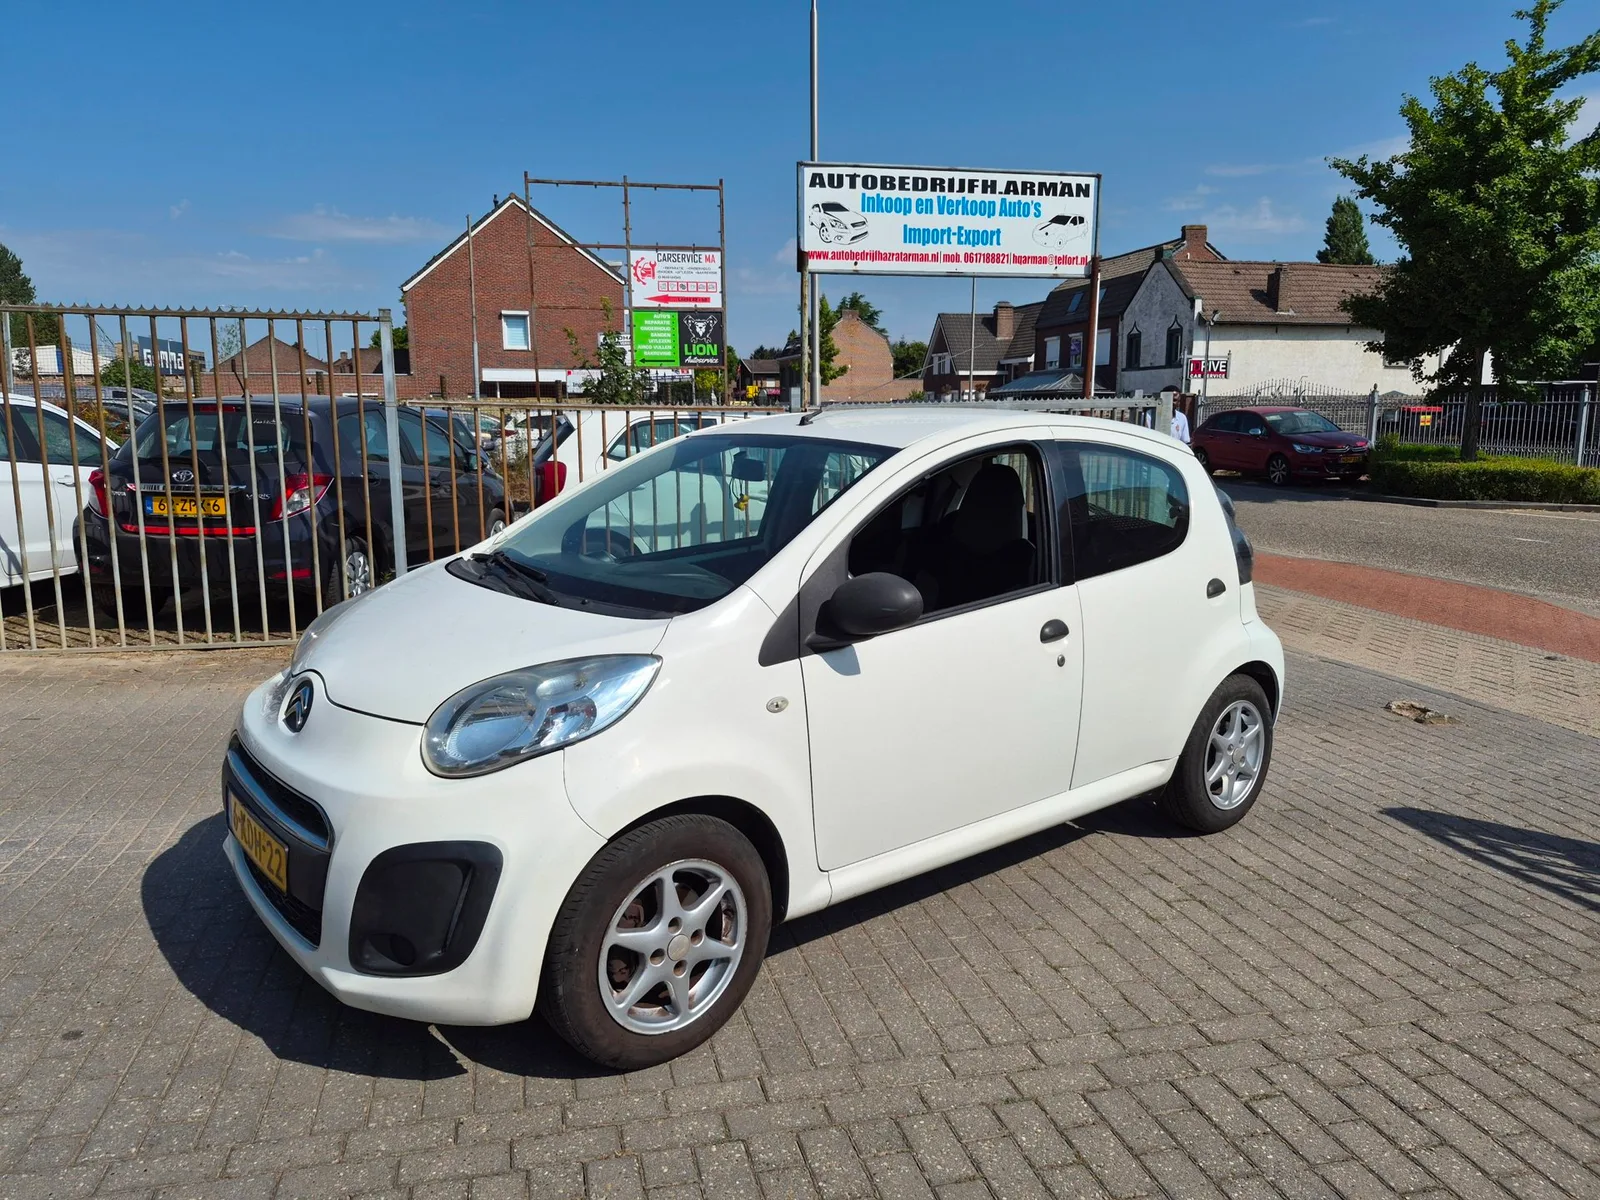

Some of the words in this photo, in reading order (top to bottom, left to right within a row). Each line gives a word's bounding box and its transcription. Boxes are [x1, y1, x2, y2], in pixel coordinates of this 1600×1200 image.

[861, 192, 912, 216] Inkoop
[915, 197, 934, 215] en
[937, 195, 996, 219] Verkoop
[999, 197, 1042, 219] Auto's
[903, 224, 1002, 248] Import-Export
[657, 253, 703, 264] CARSERVICE
[704, 255, 716, 264] MA
[943, 252, 963, 264] mob.
[964, 252, 1010, 265] 0617188821
[684, 343, 718, 356] LION
[684, 355, 719, 363] Autoservice
